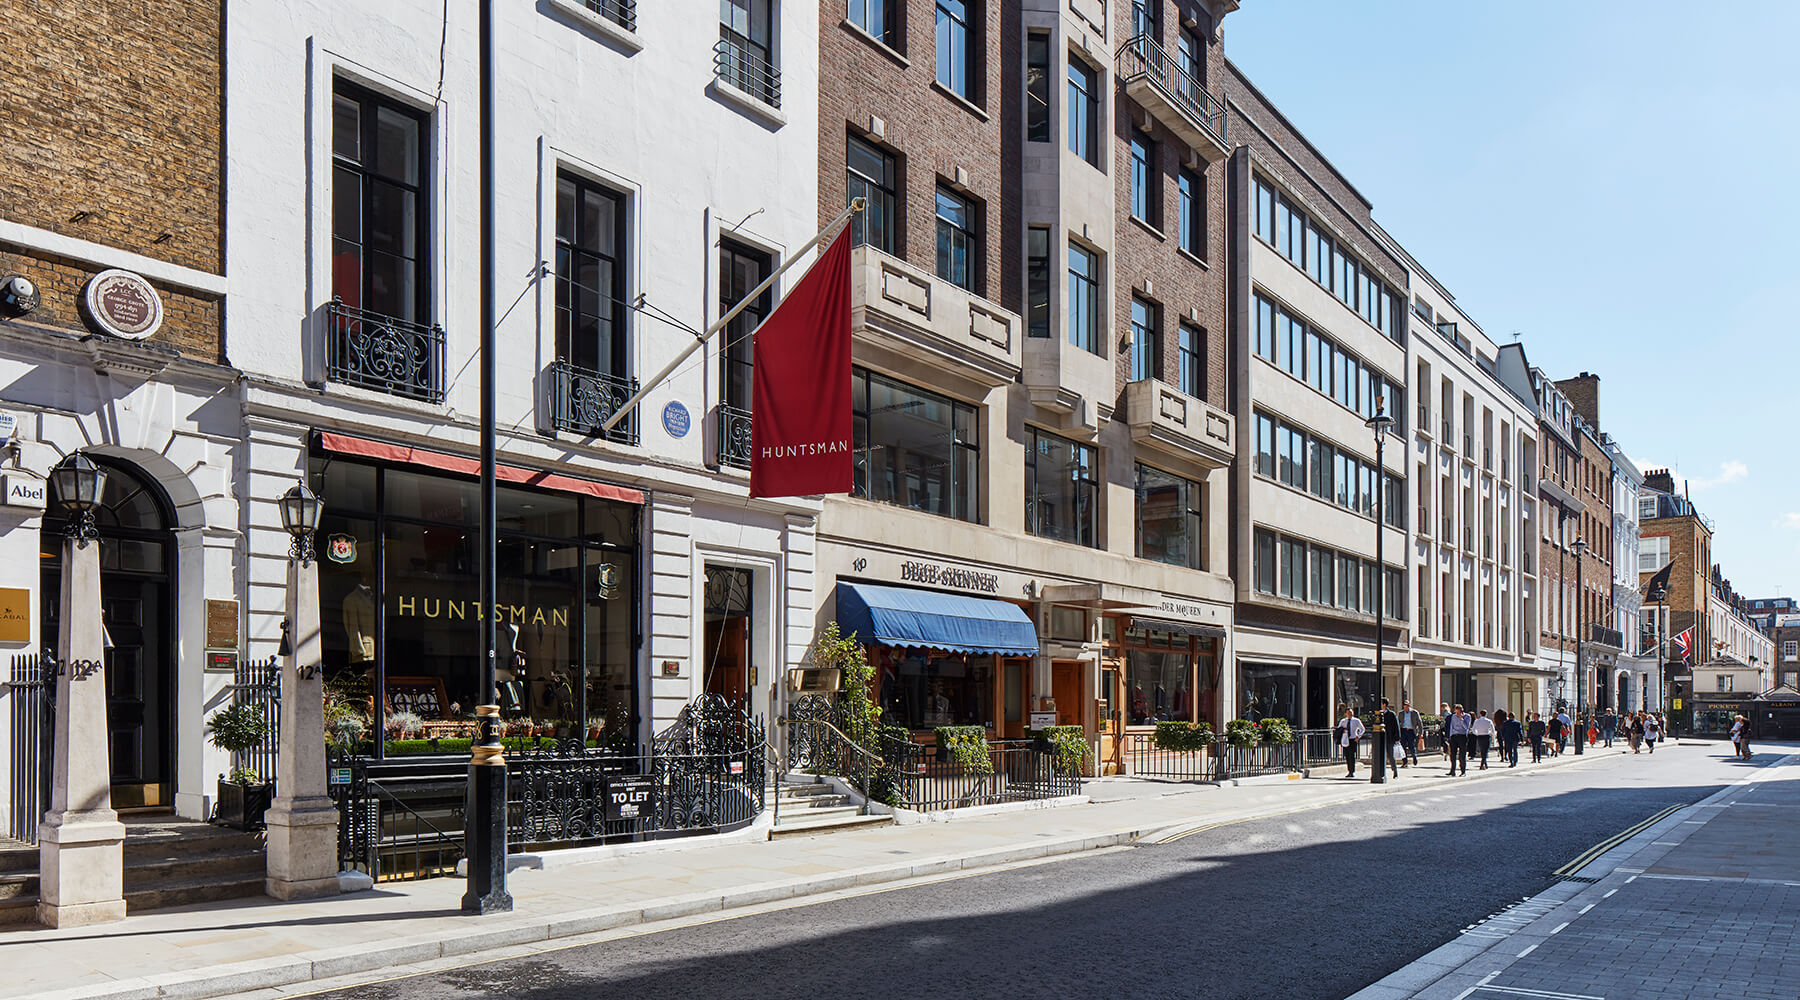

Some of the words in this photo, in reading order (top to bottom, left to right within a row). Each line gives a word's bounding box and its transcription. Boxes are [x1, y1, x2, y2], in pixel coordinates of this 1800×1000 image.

[666, 410, 688, 423] BRIGHT
[762, 440, 848, 458] HUNTSMAN
[11, 484, 43, 500] Abel
[901, 560, 940, 585] DEGE
[942, 566, 1000, 593] SKINNER
[399, 596, 567, 627] HUNTSMAN
[488, 649, 495, 658] 8
[297, 665, 322, 680] 12A
[611, 792, 628, 804] TO
[629, 791, 649, 802] LET
